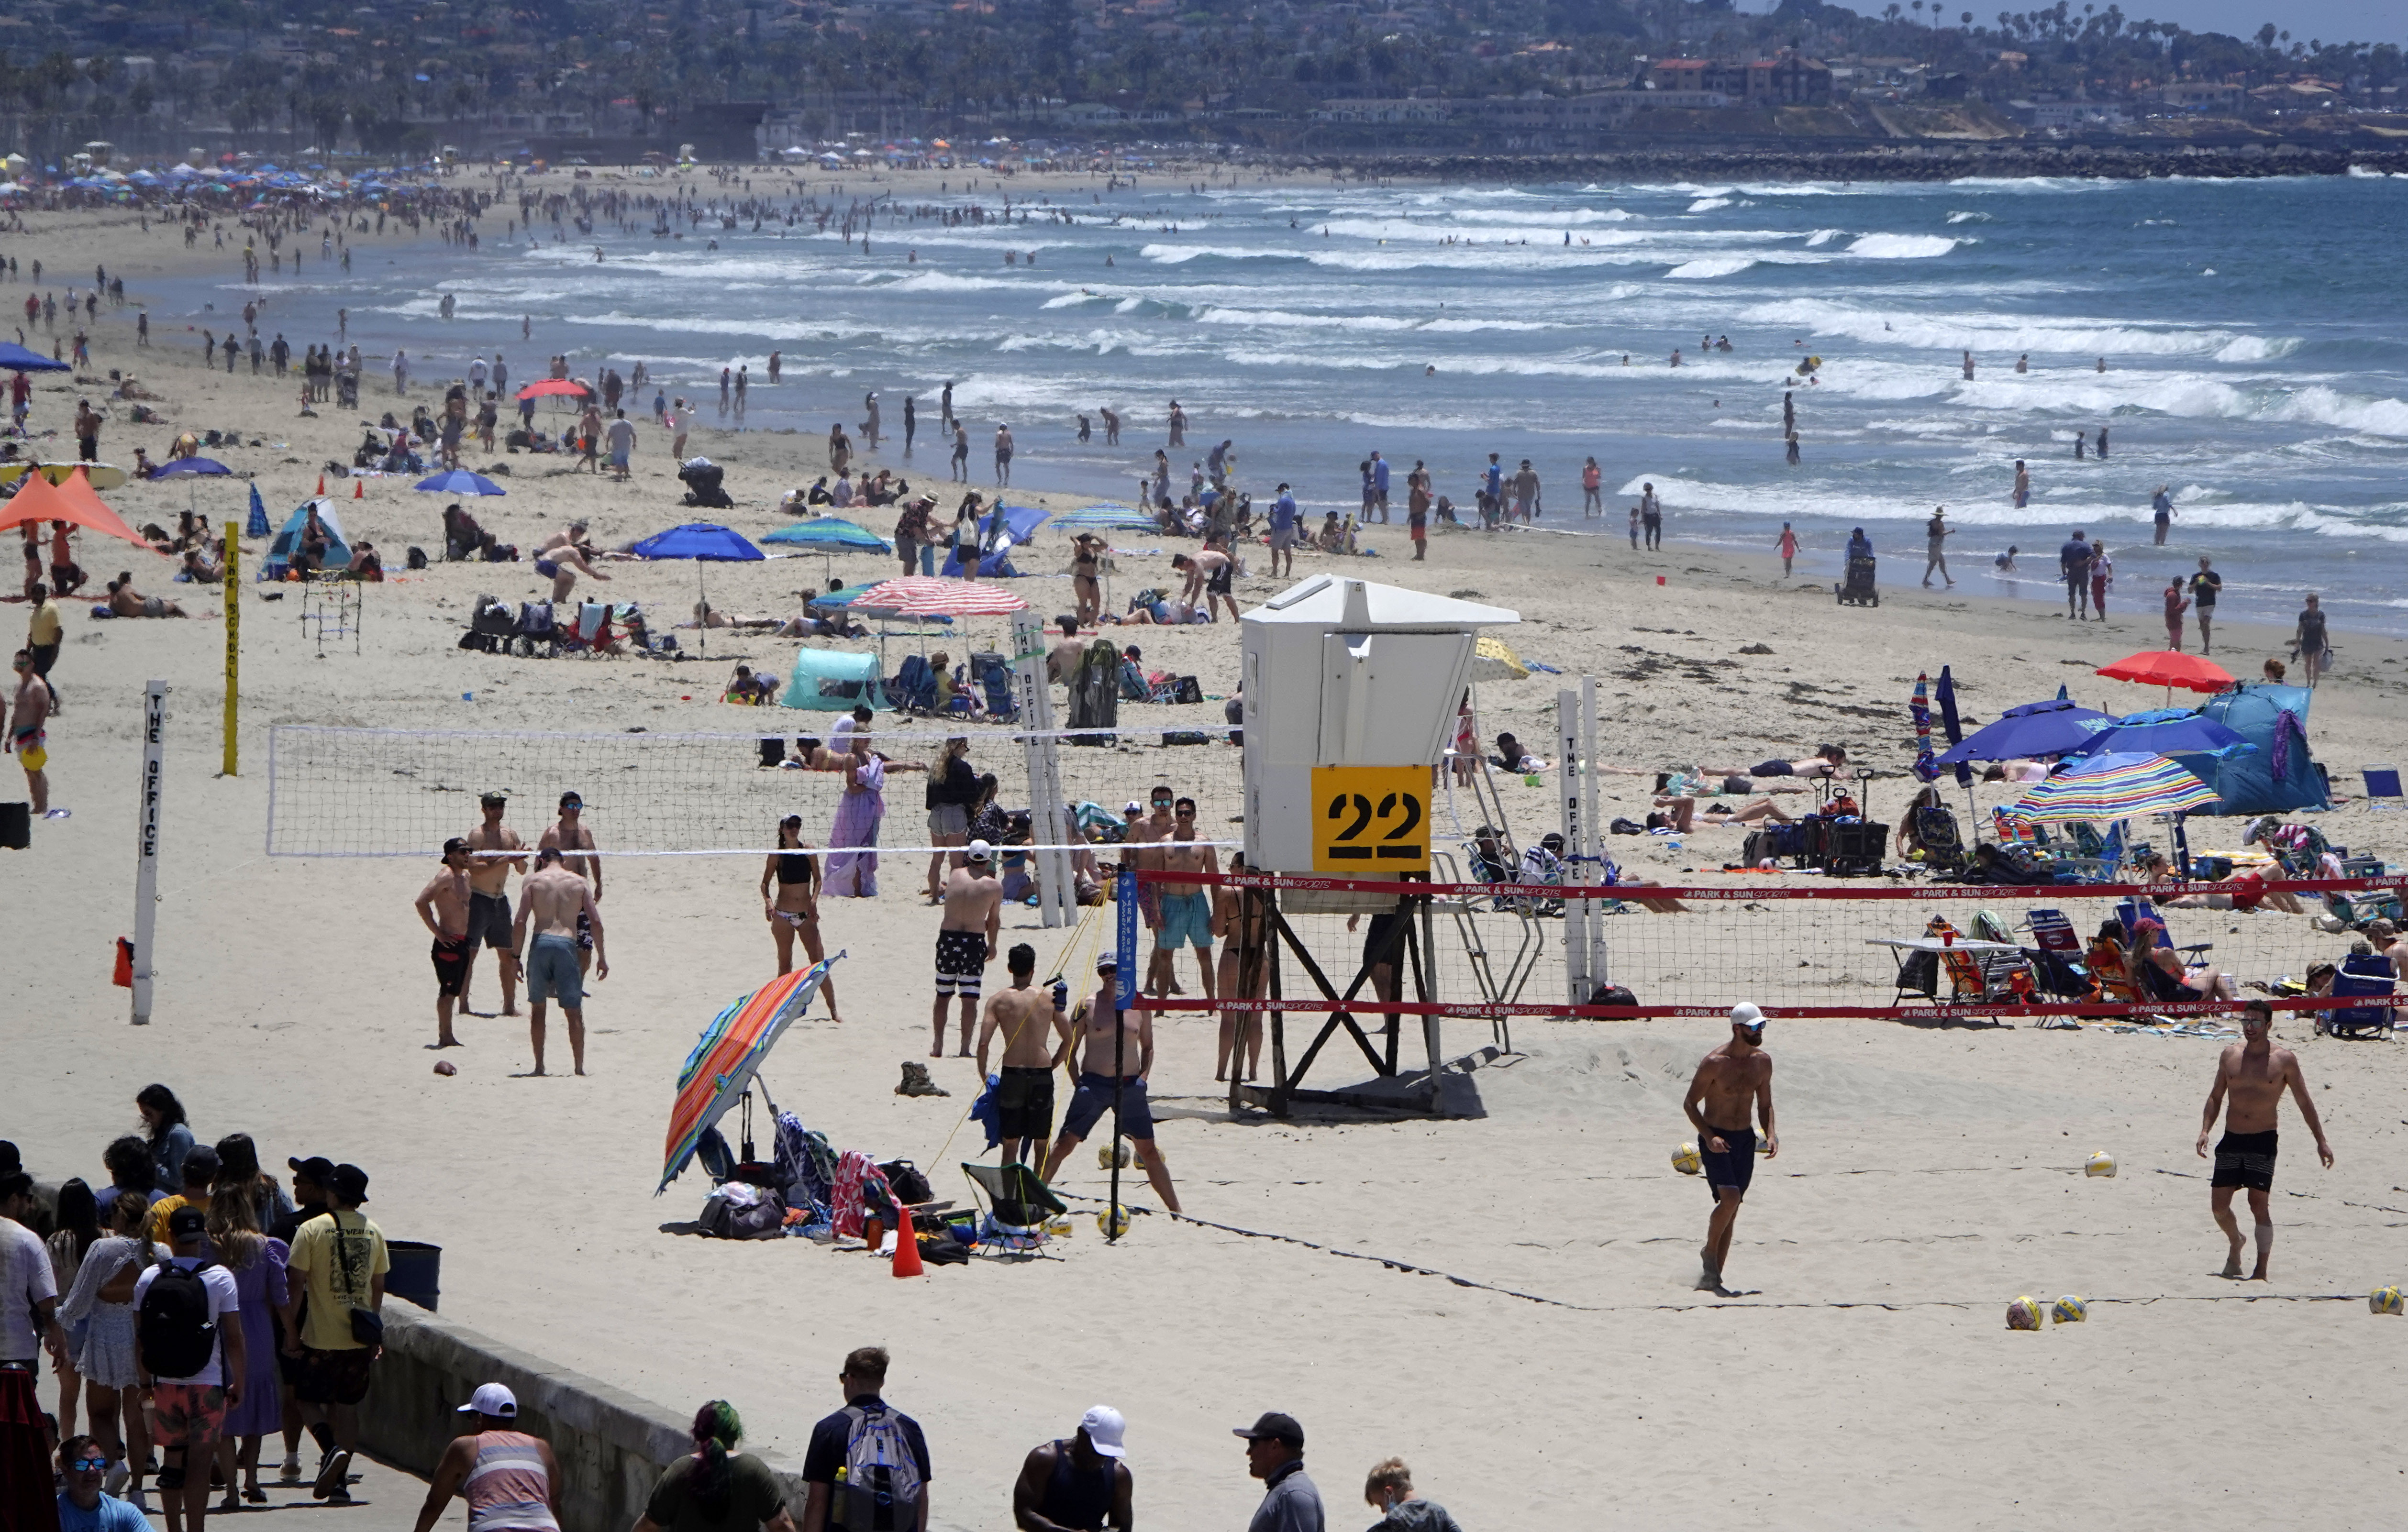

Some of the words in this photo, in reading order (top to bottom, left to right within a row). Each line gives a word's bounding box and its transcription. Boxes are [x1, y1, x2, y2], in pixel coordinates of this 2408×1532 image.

[149, 694, 161, 743] THE
[1567, 738, 1575, 777] THE
[144, 760, 159, 856] OFFICE
[1327, 792, 1422, 859] 22
[1235, 876, 1260, 885] PARK
[1263, 878, 1271, 886] &
[2375, 877, 2402, 886] PARK
[1465, 885, 1491, 893] PARK
[1494, 886, 1501, 894] &
[1922, 889, 1949, 897] PARK
[2150, 884, 2175, 893] PARK
[1694, 890, 1721, 898] PARK
[1227, 1002, 1254, 1010] PARK
[1456, 1006, 1482, 1014] PARK
[2139, 1005, 2165, 1013] PARK
[2167, 1004, 2175, 1013] &
[1912, 1009, 1938, 1017] PARK
